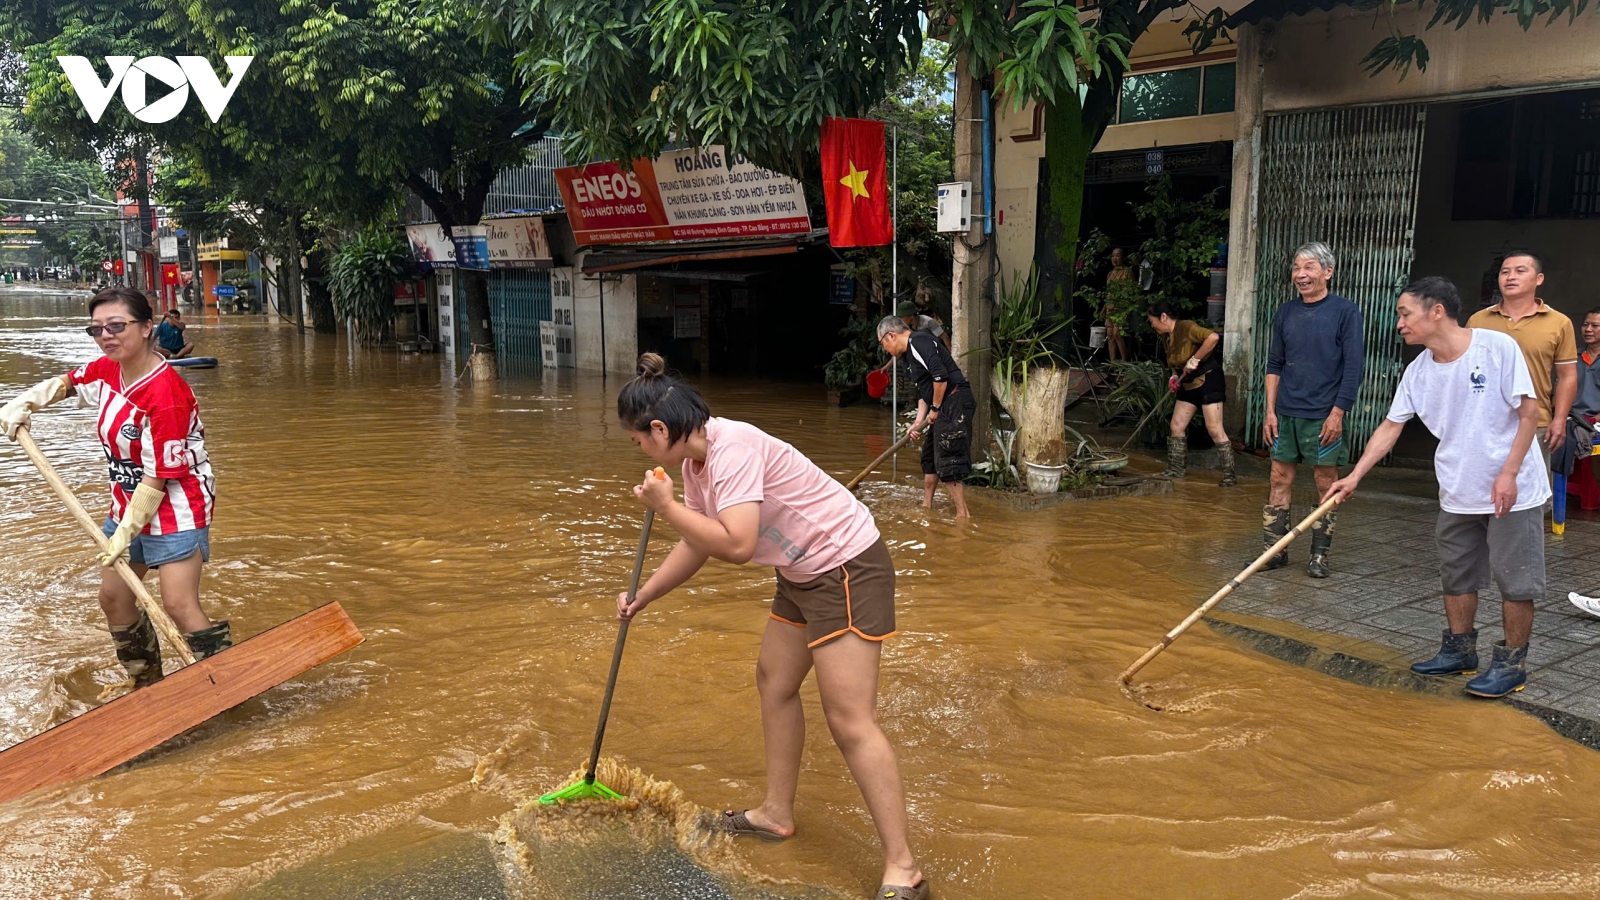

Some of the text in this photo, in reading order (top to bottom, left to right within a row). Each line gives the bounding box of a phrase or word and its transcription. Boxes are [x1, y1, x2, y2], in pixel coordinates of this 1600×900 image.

[1147, 152, 1162, 161] 038
[1147, 164, 1162, 174] 040
[571, 171, 641, 203] ENEOS
[659, 180, 679, 191] TRUNG
[691, 193, 700, 203] XE
[700, 192, 710, 203] GA
[712, 191, 722, 202] XE
